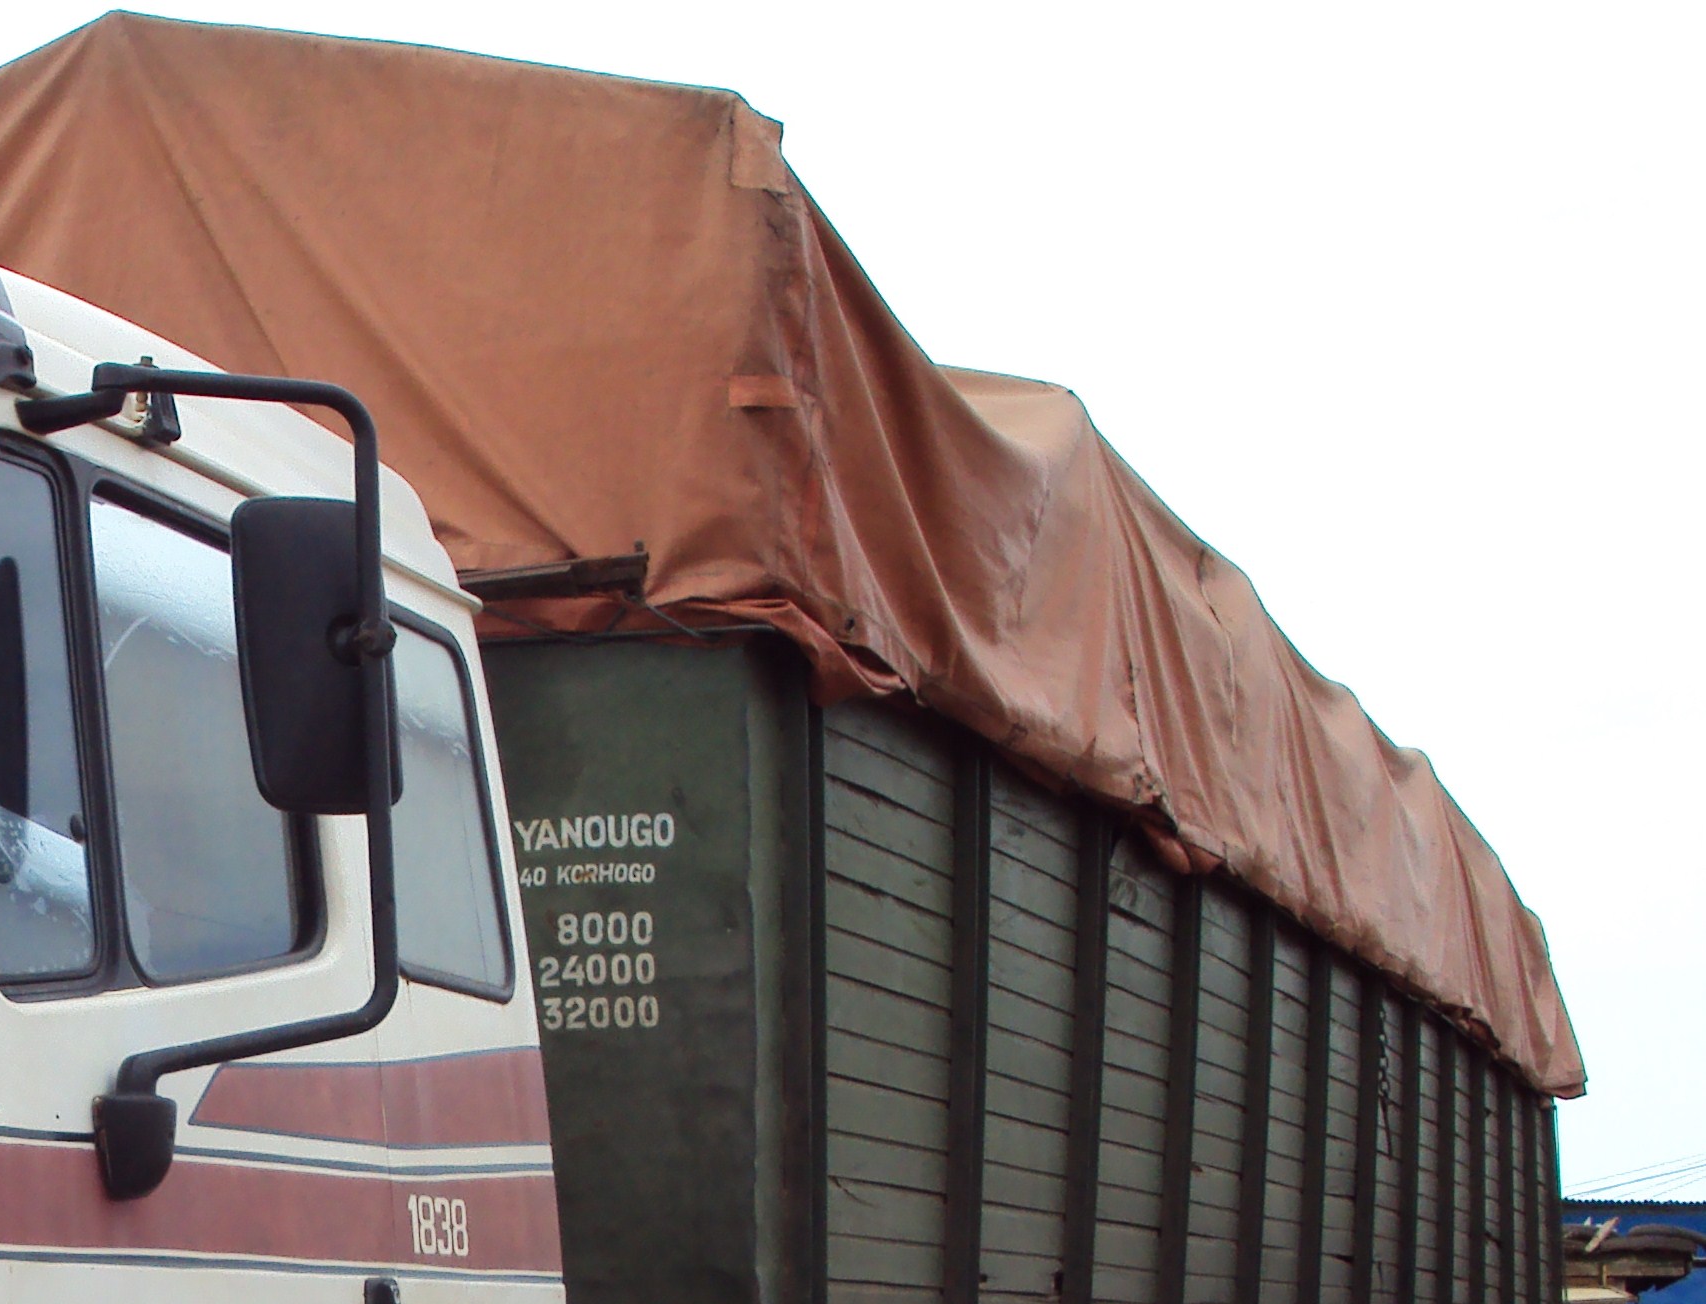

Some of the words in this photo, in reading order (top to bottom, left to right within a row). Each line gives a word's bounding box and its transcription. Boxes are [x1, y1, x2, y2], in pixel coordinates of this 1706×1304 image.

[514, 813, 675, 851] YANOUGO
[519, 866, 546, 888] 40
[557, 863, 655, 885] KORHOGO
[557, 911, 654, 945] 8000
[539, 953, 656, 988] 24000
[543, 995, 660, 1031] 32000
[407, 1194, 469, 1257] 1838
